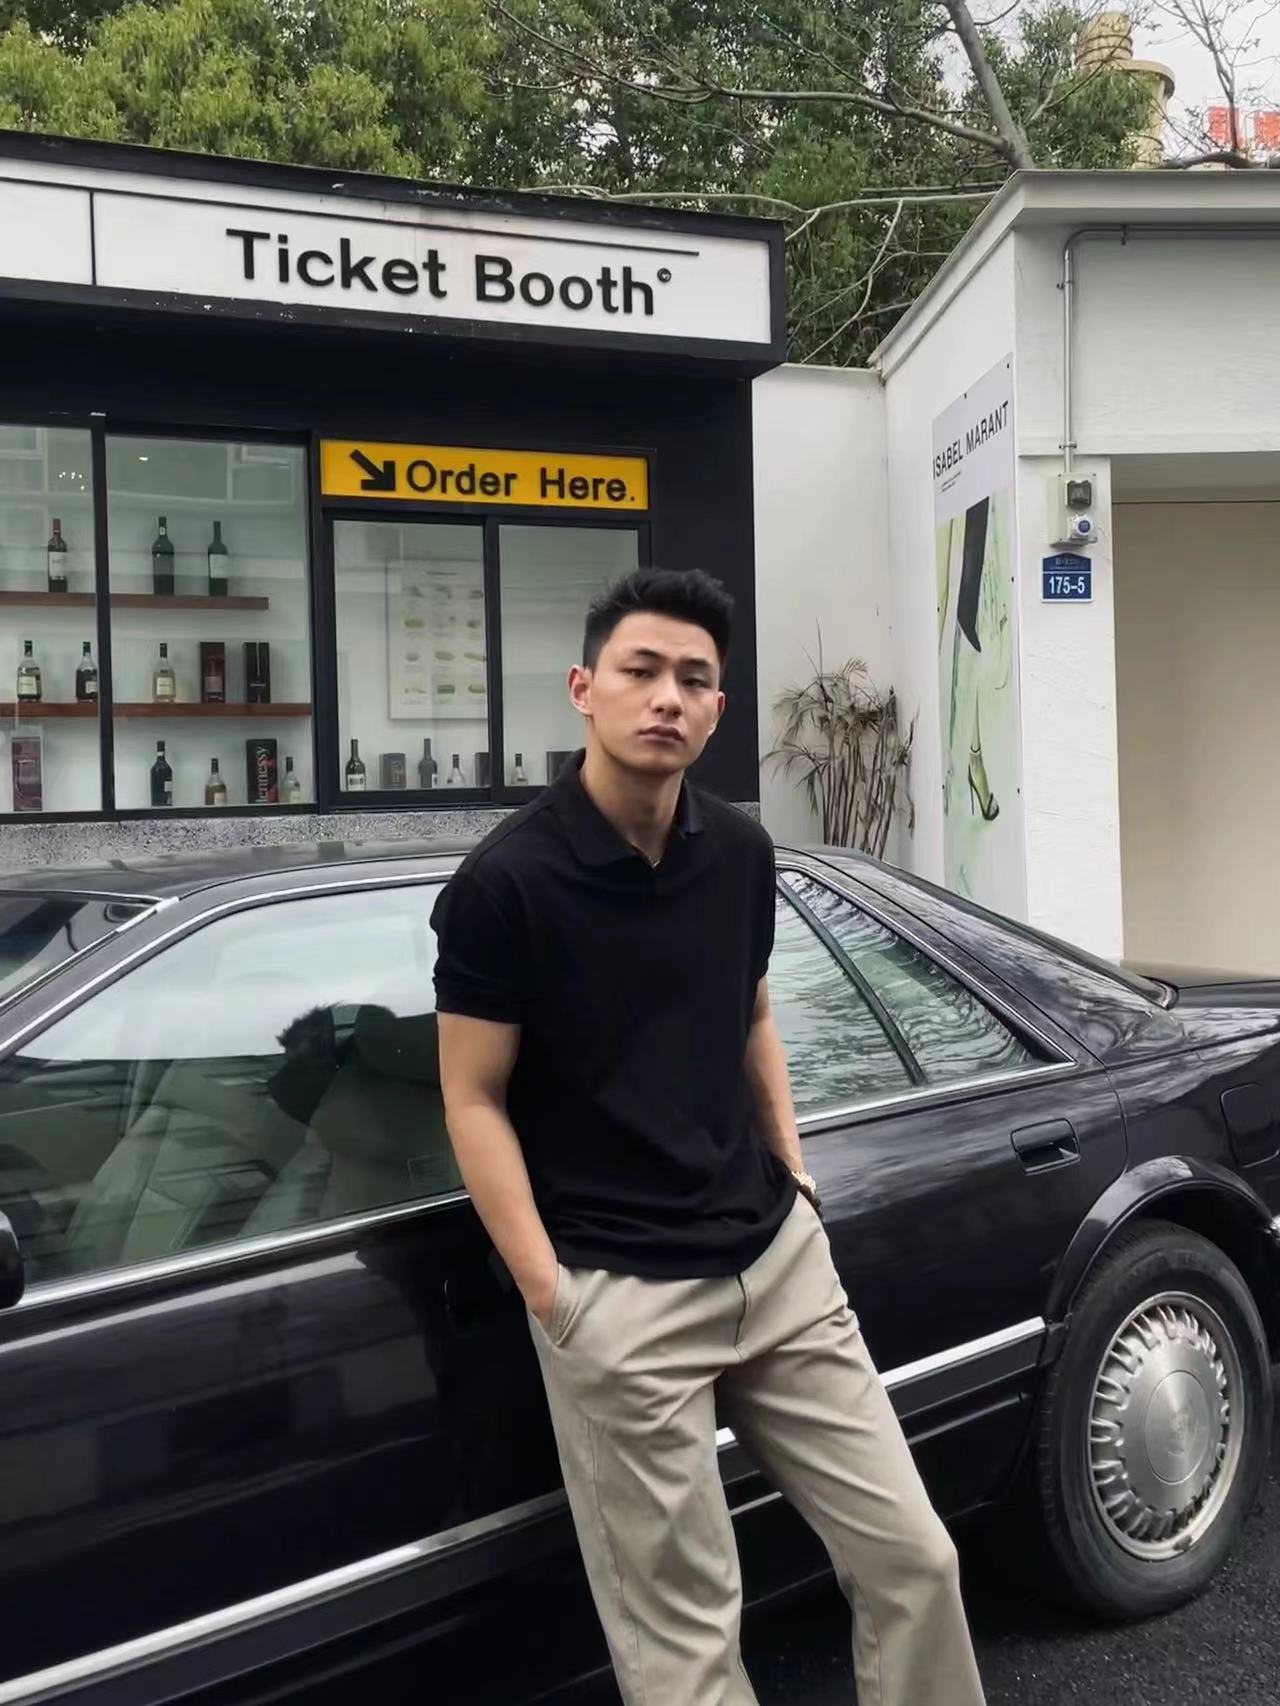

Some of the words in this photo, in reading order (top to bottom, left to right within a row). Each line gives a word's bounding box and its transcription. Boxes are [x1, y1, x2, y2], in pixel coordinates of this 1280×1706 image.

[226, 228, 448, 299] Ticket
[932, 439, 964, 481] ISABEL
[965, 400, 1009, 456] MARANT
[406, 459, 518, 498] Order
[539, 467, 636, 503] Here.
[1048, 576, 1086, 594] 175-5
